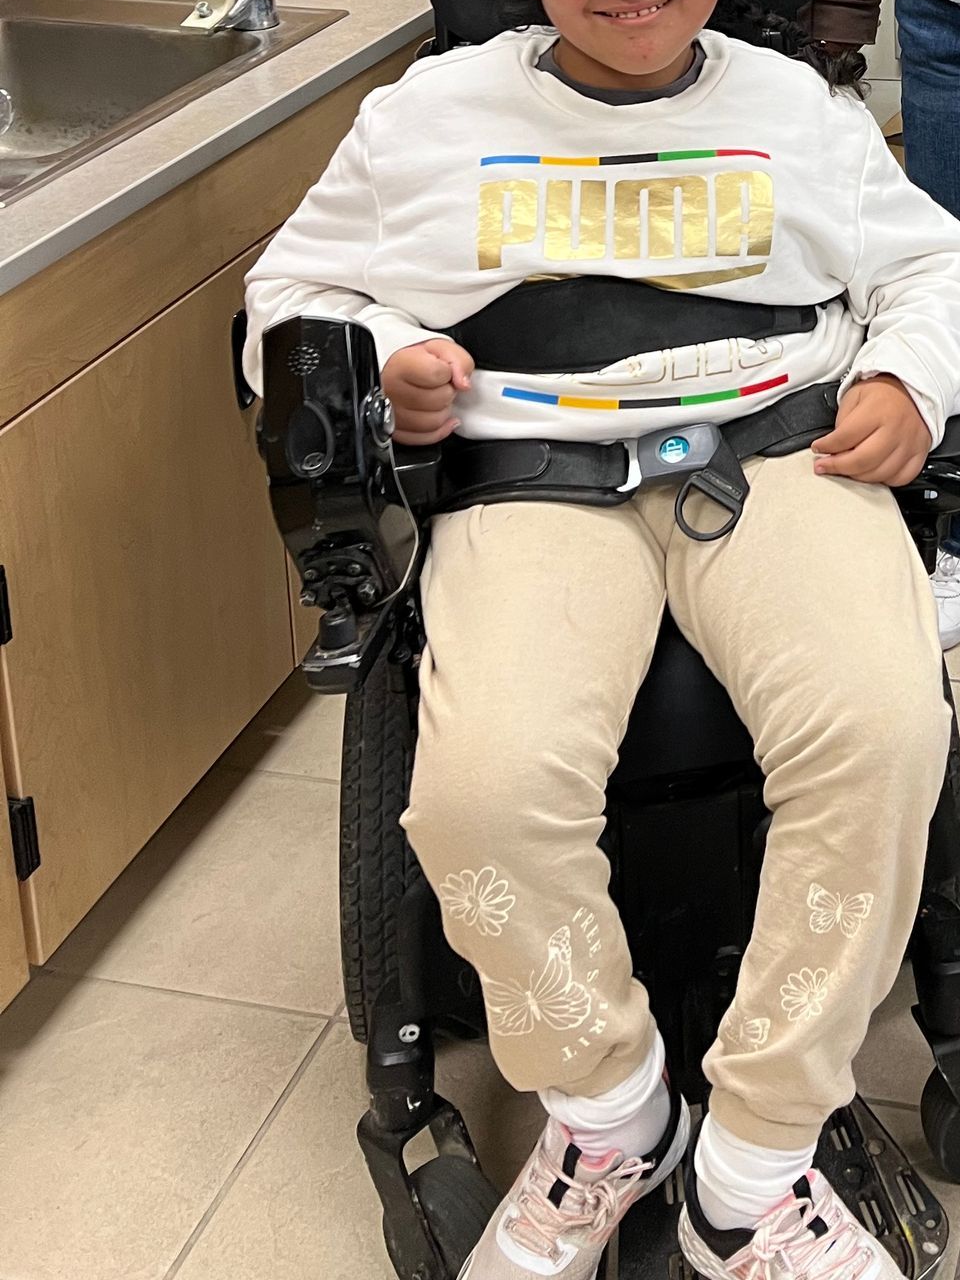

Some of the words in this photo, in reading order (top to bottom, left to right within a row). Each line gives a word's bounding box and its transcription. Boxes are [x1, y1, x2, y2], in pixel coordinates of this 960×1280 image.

[477, 170, 774, 271] PUMA
[572, 906, 602, 958] FREE
[561, 969, 609, 1061] SIRIT
